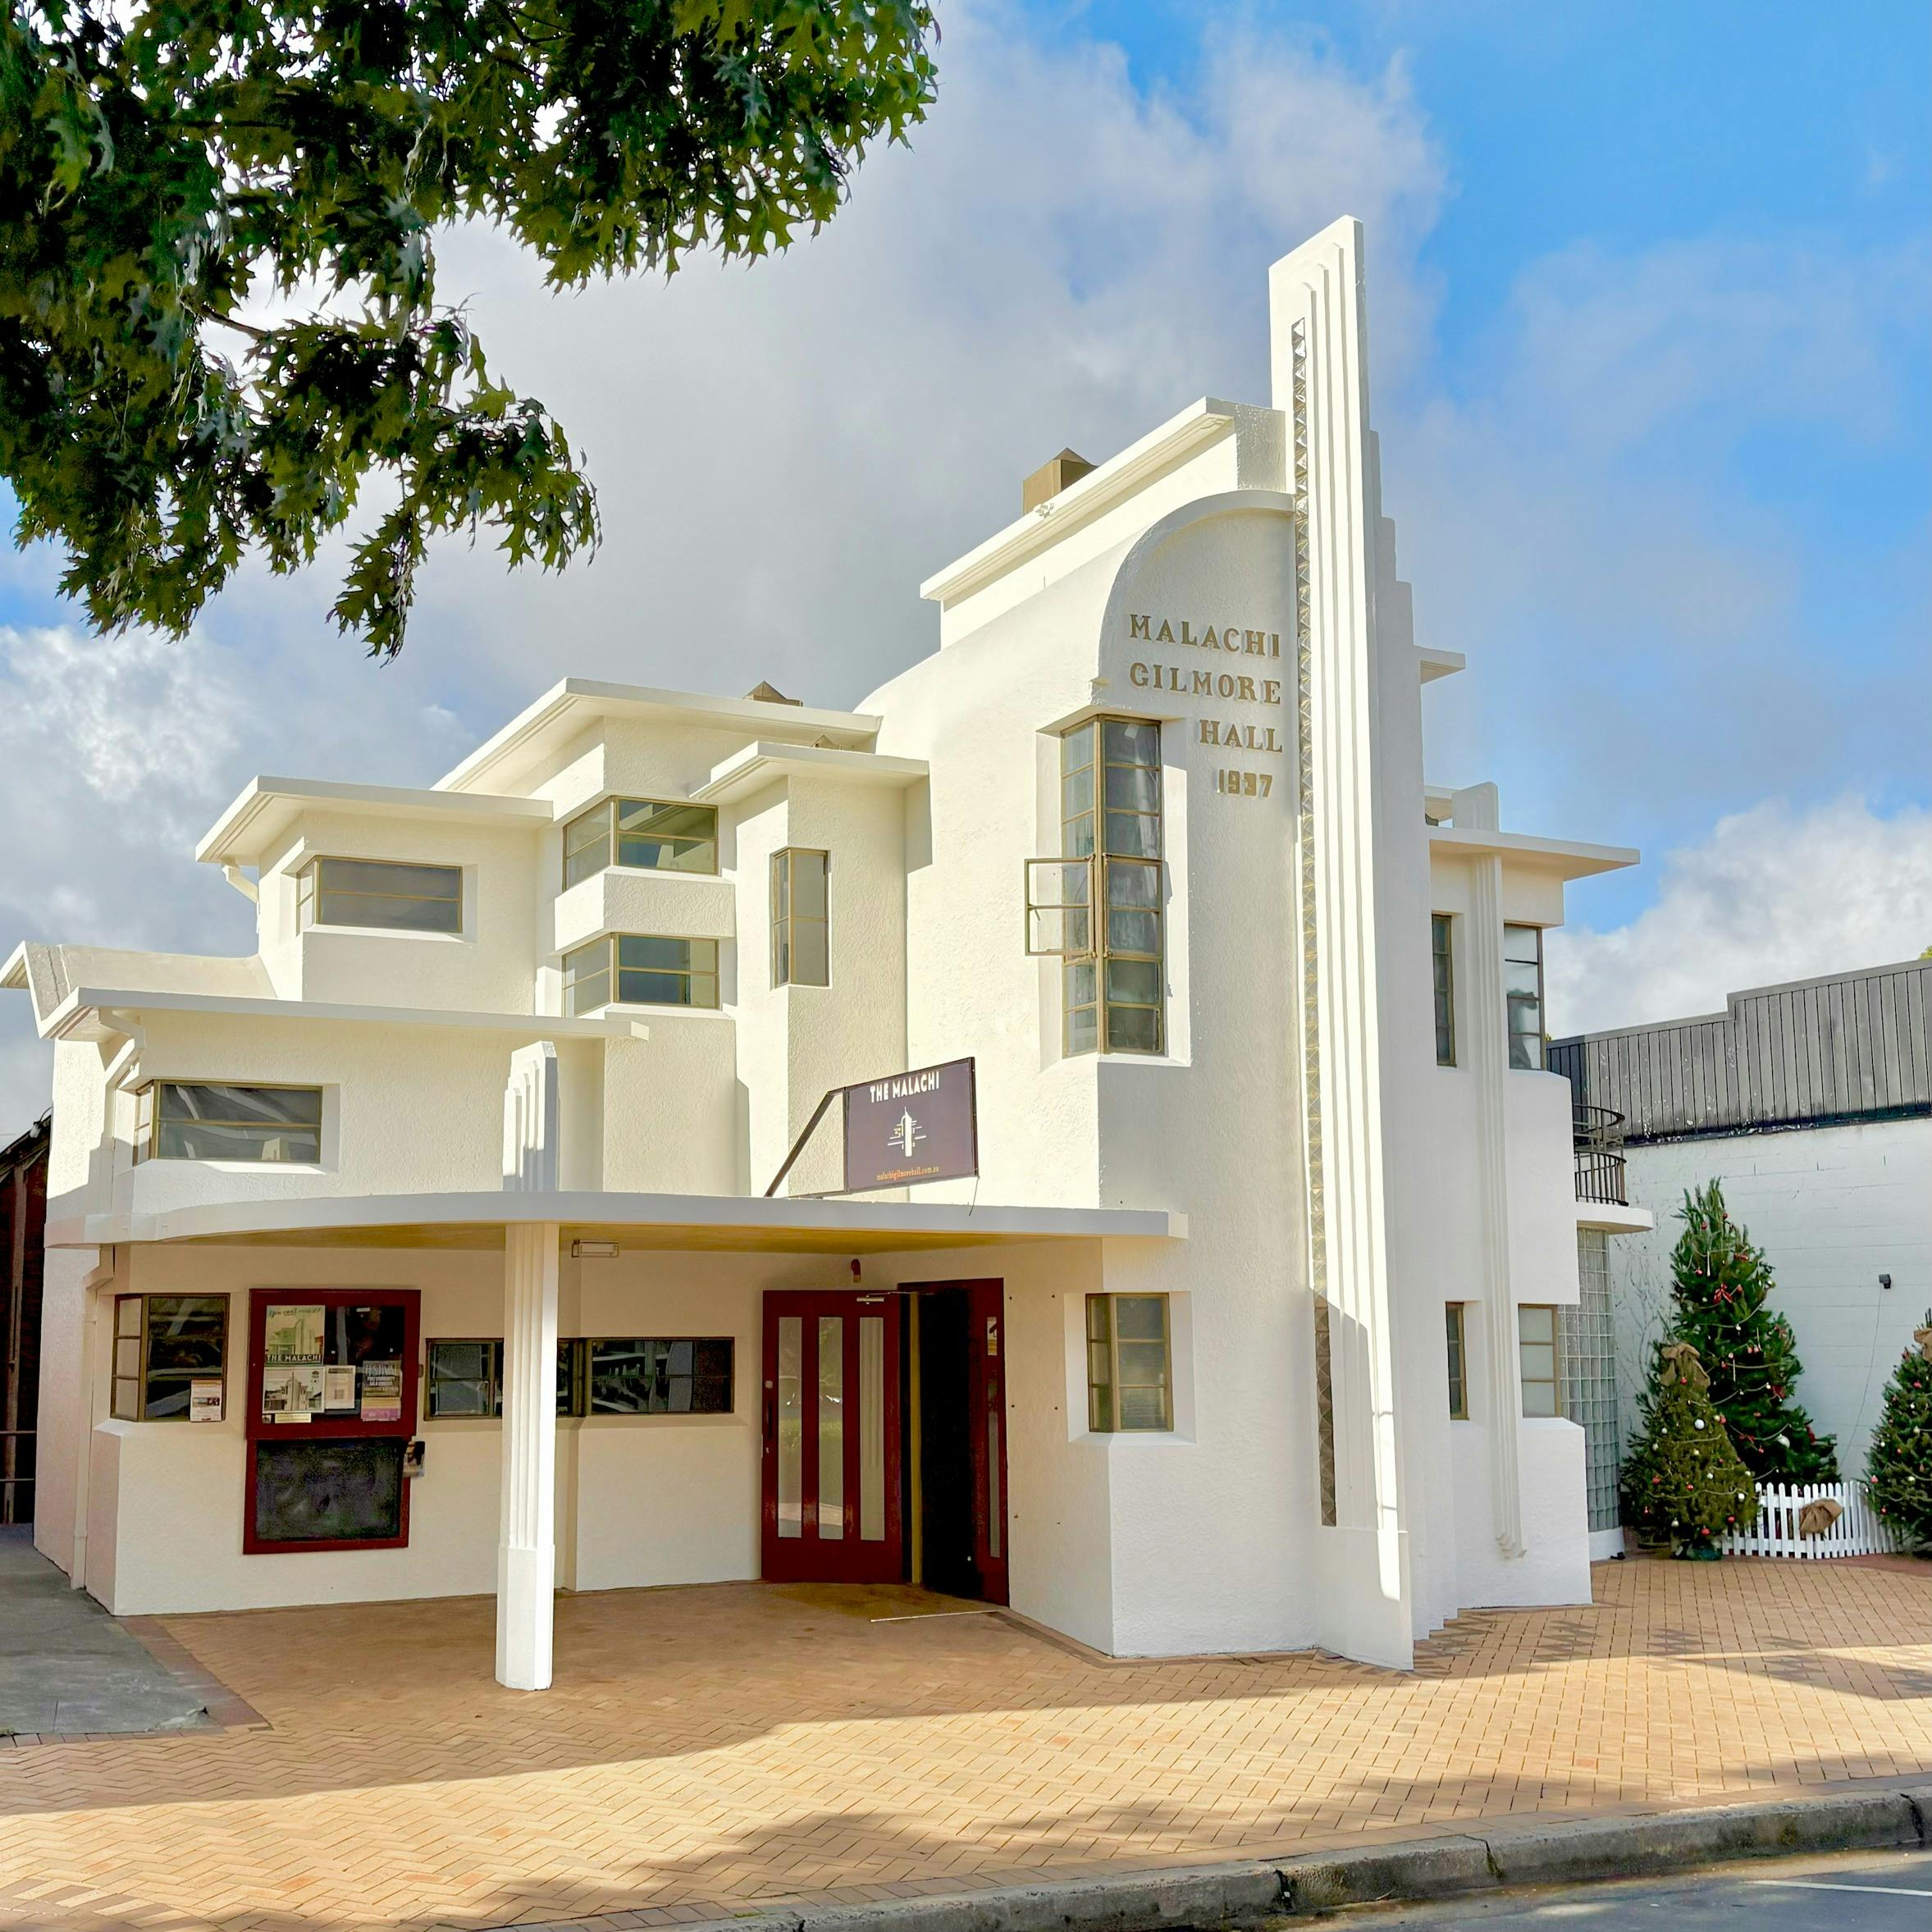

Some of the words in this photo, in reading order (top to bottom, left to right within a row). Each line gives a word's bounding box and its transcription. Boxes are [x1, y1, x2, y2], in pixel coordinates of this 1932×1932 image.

[1130, 614, 1281, 658] MALACHI
[1130, 662, 1281, 706] GILMORE
[1199, 719, 1283, 753] HALL
[1218, 769, 1273, 798] 1937
[870, 1082, 889, 1103] THE
[892, 1071, 940, 1099] MALACHI
[875, 1166, 939, 1181] malachigilmorehall.com.au
[284, 1354, 322, 1363] MALACHI
